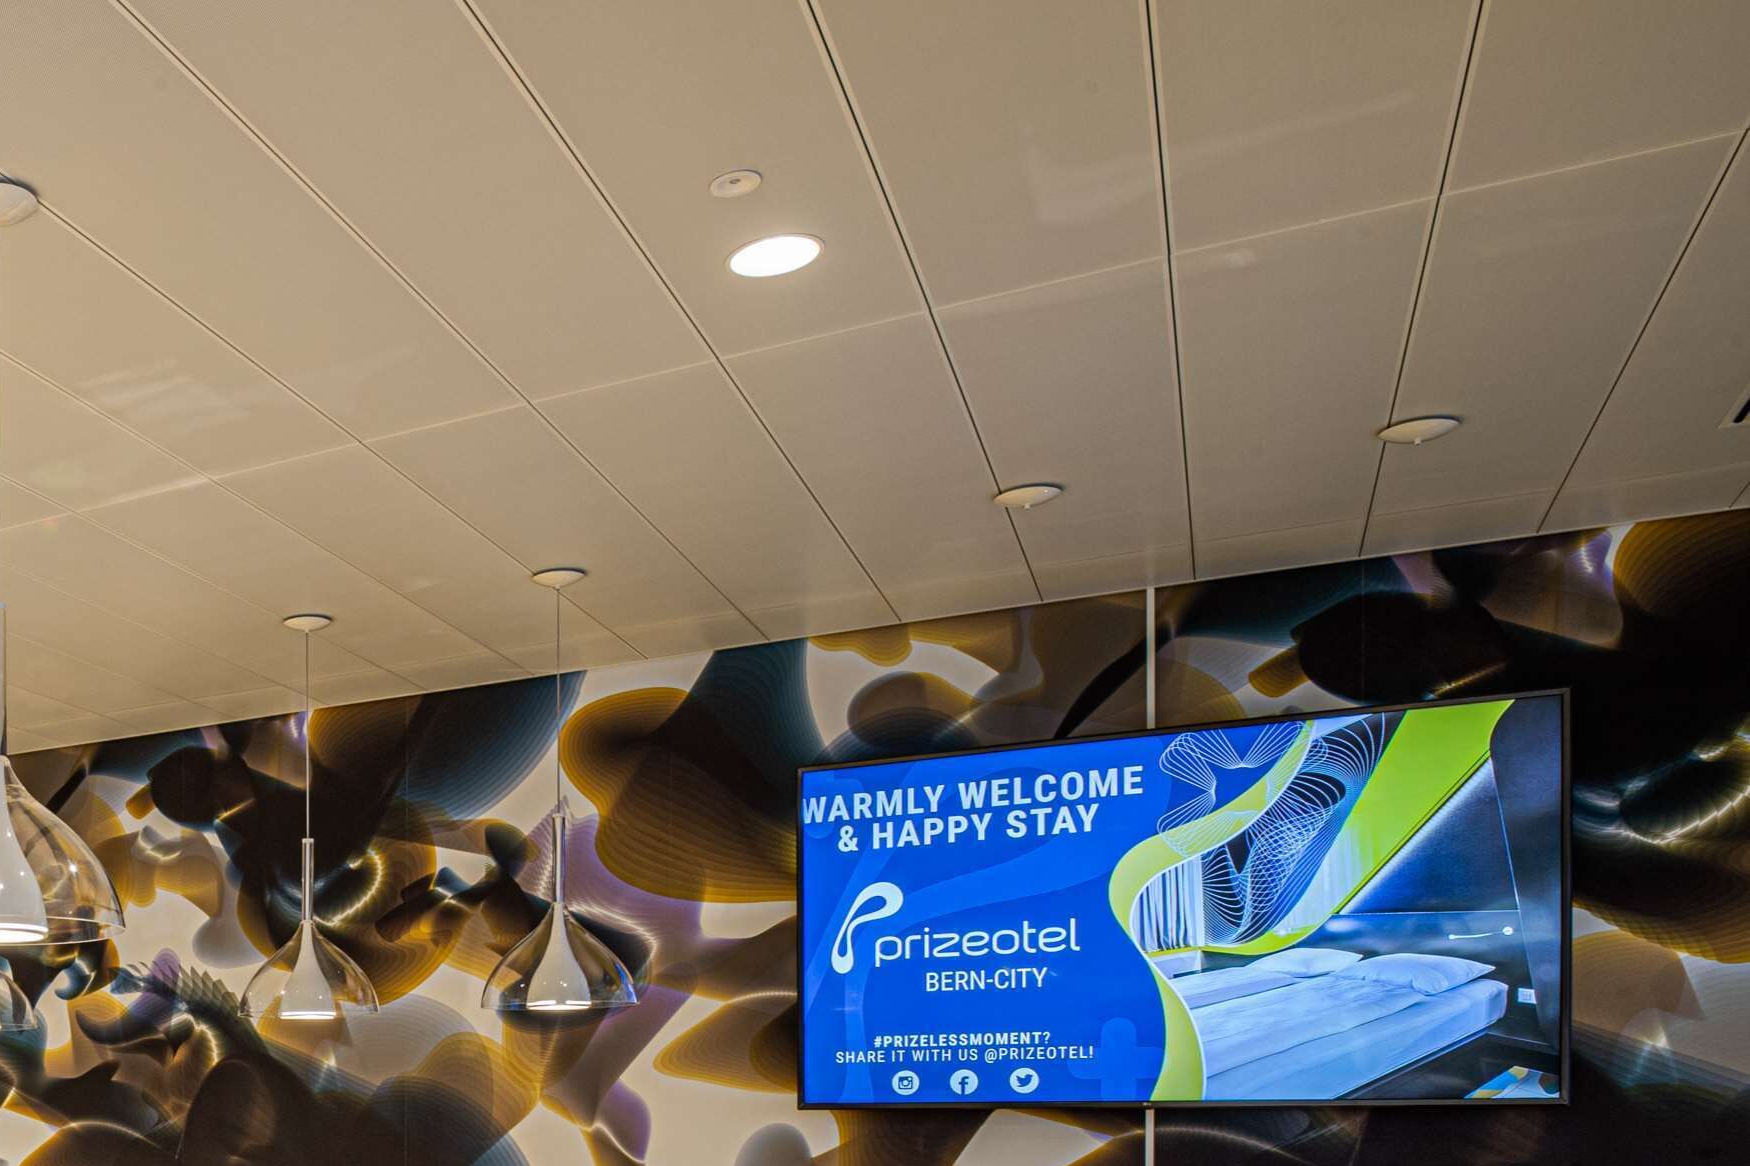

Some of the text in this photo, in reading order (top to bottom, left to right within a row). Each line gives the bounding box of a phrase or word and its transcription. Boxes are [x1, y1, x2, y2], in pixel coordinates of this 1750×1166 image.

[803, 765, 1144, 824] WARMLY WELCOME
[837, 803, 1099, 852] & HAPPY STAY
[874, 917, 1081, 968] prizeotel
[925, 966, 1048, 992] BERN-CITY
[835, 1045, 1094, 1064] SHARE IT WITH US @PRIZEOTEL!
[873, 1031, 1051, 1048] #PRIZELESSMOMENT?
